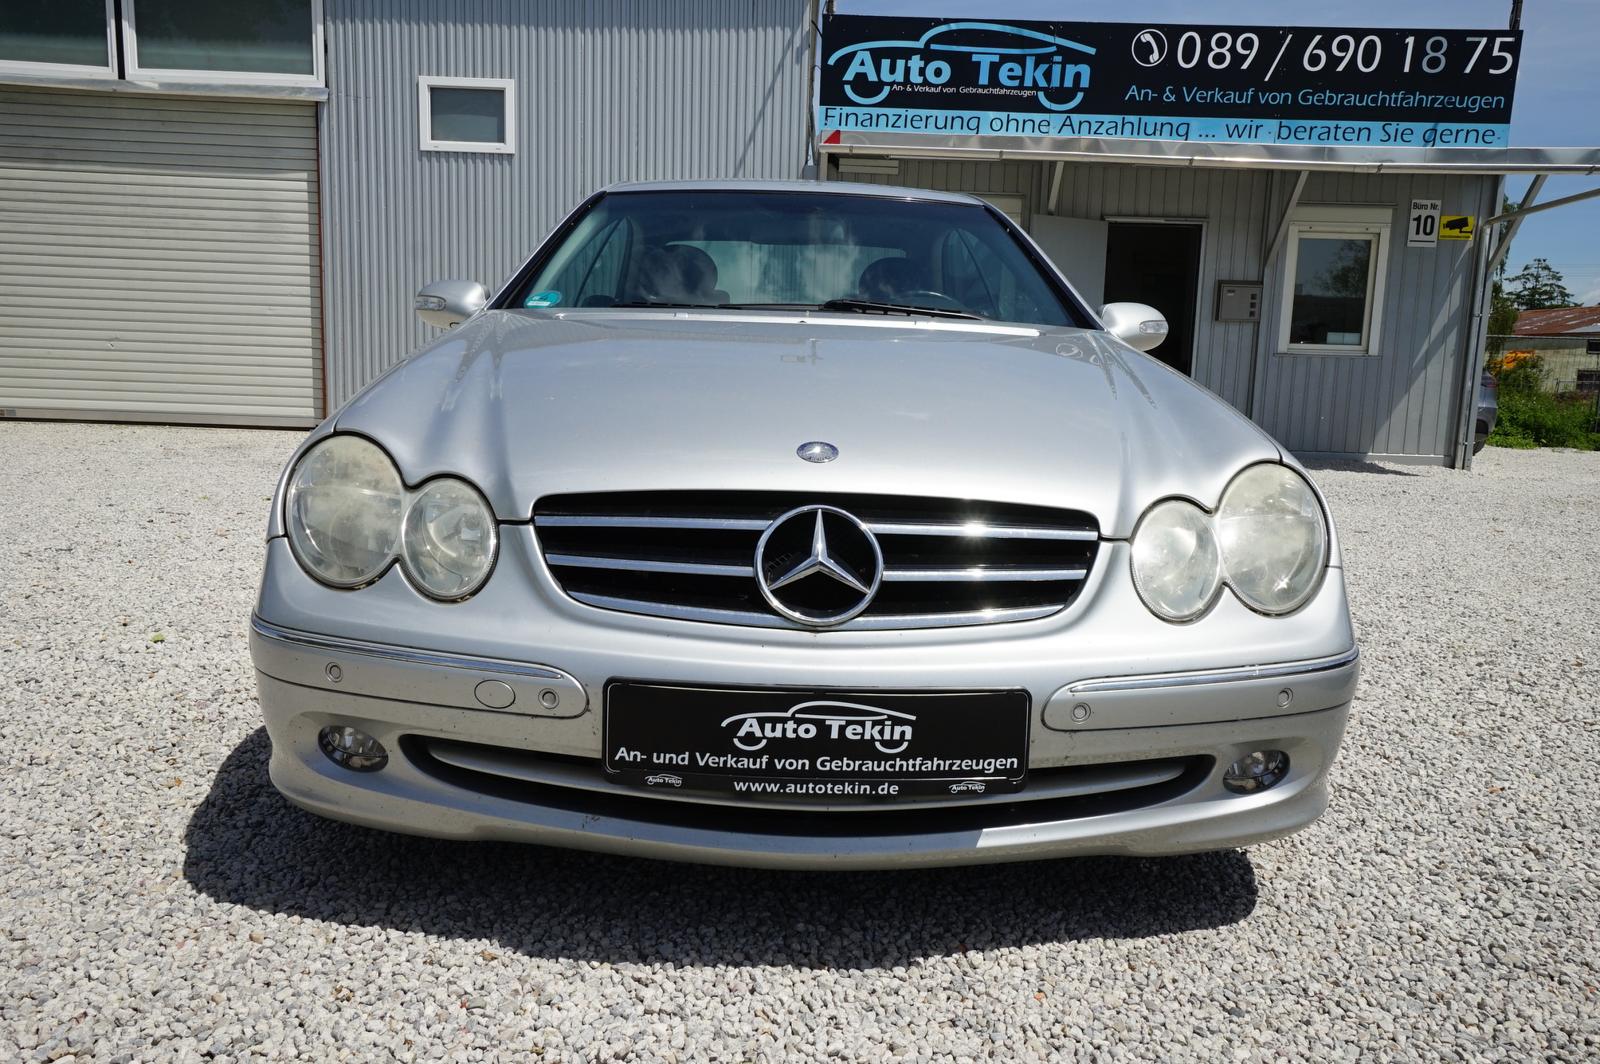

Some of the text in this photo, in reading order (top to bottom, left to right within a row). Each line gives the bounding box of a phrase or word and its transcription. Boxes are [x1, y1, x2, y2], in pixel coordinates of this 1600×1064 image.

[842, 50, 1091, 89] Auto Tekin
[1176, 31, 1516, 82] 089 / 690 18 75
[891, 84, 905, 92] An-
[913, 85, 942, 93] Verkauf
[959, 86, 1037, 98] Gebrauchtfahrzeugen
[1125, 84, 1505, 113] An- & Verkauf von Gebrauchtfahrzeugen
[824, 107, 981, 135] Finanzierung
[989, 113, 1051, 134] ohne
[1057, 115, 1191, 141] Anzahlung
[1225, 119, 1264, 139] wir
[1277, 121, 1372, 142] beraten
[1380, 122, 1414, 143] Sie
[1422, 127, 1496, 148] gerne
[1412, 202, 1440, 211] Büro Nr.
[1412, 214, 1435, 236] 10
[736, 718, 913, 742] Auto Tekin
[614, 746, 1018, 774] An- und Verkauf von Gebrauchtfahrzeugen
[733, 780, 899, 797] www.autotekin.de
